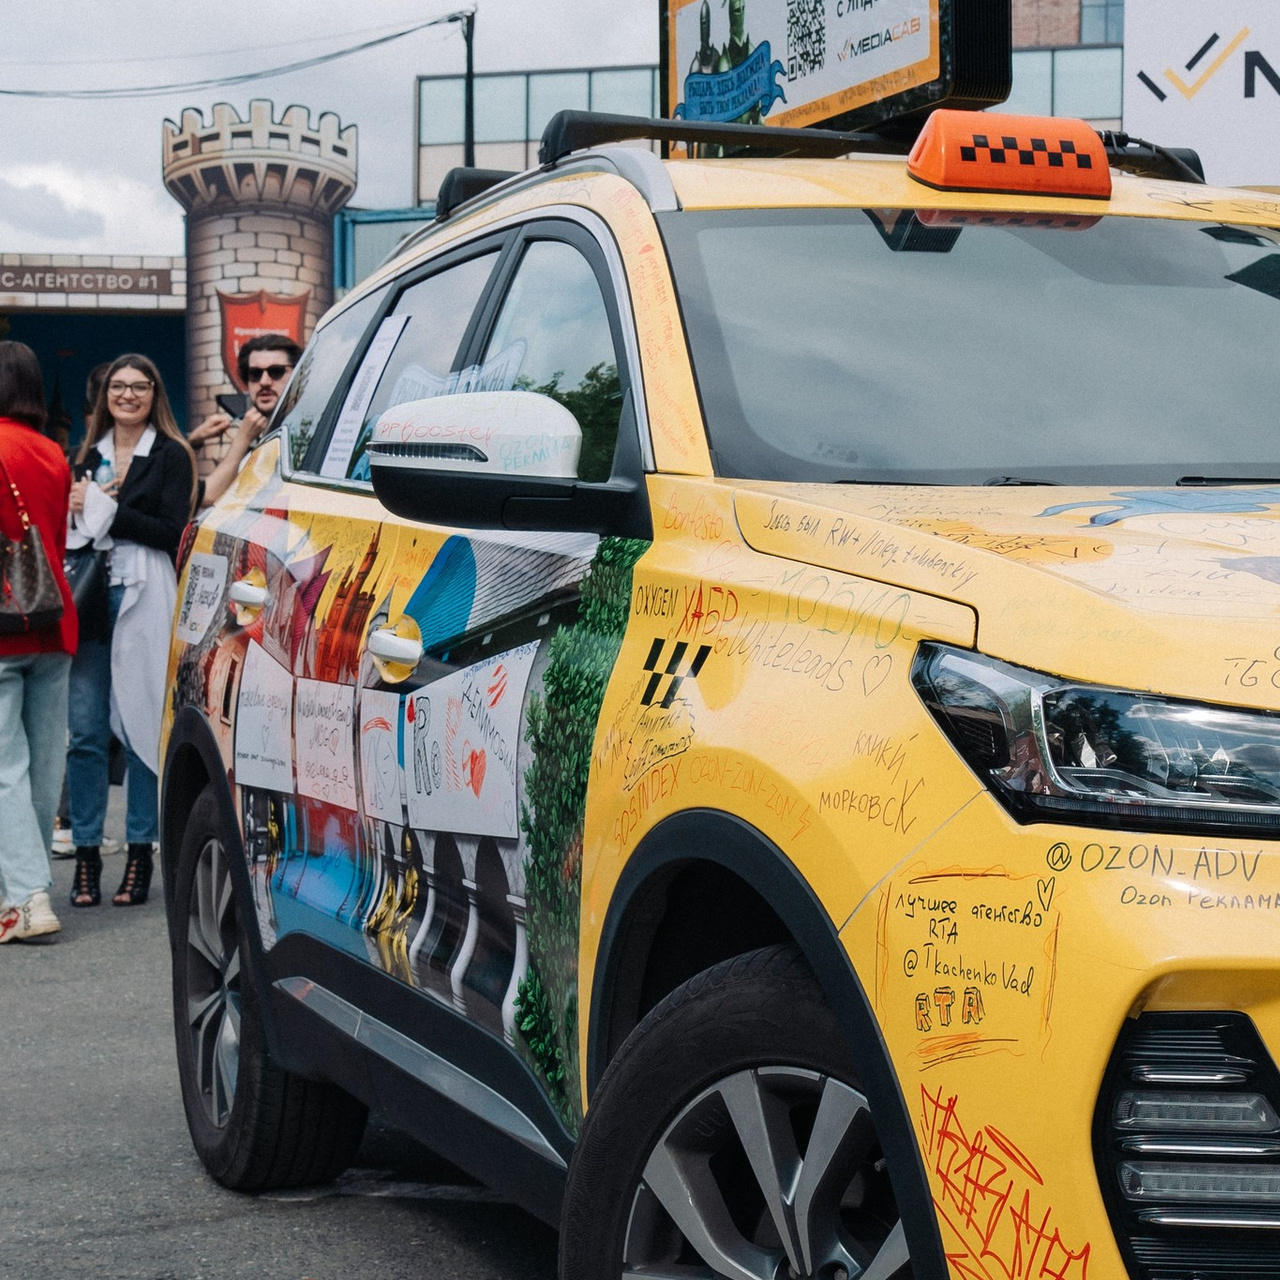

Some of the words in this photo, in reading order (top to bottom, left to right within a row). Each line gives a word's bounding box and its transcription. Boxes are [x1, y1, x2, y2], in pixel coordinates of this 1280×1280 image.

[850, 16, 921, 58] MEDIACAB
[138, 274, 158, 290] #1
[635, 584, 679, 618] OXYGEN
[928, 917, 959, 945] RTA
